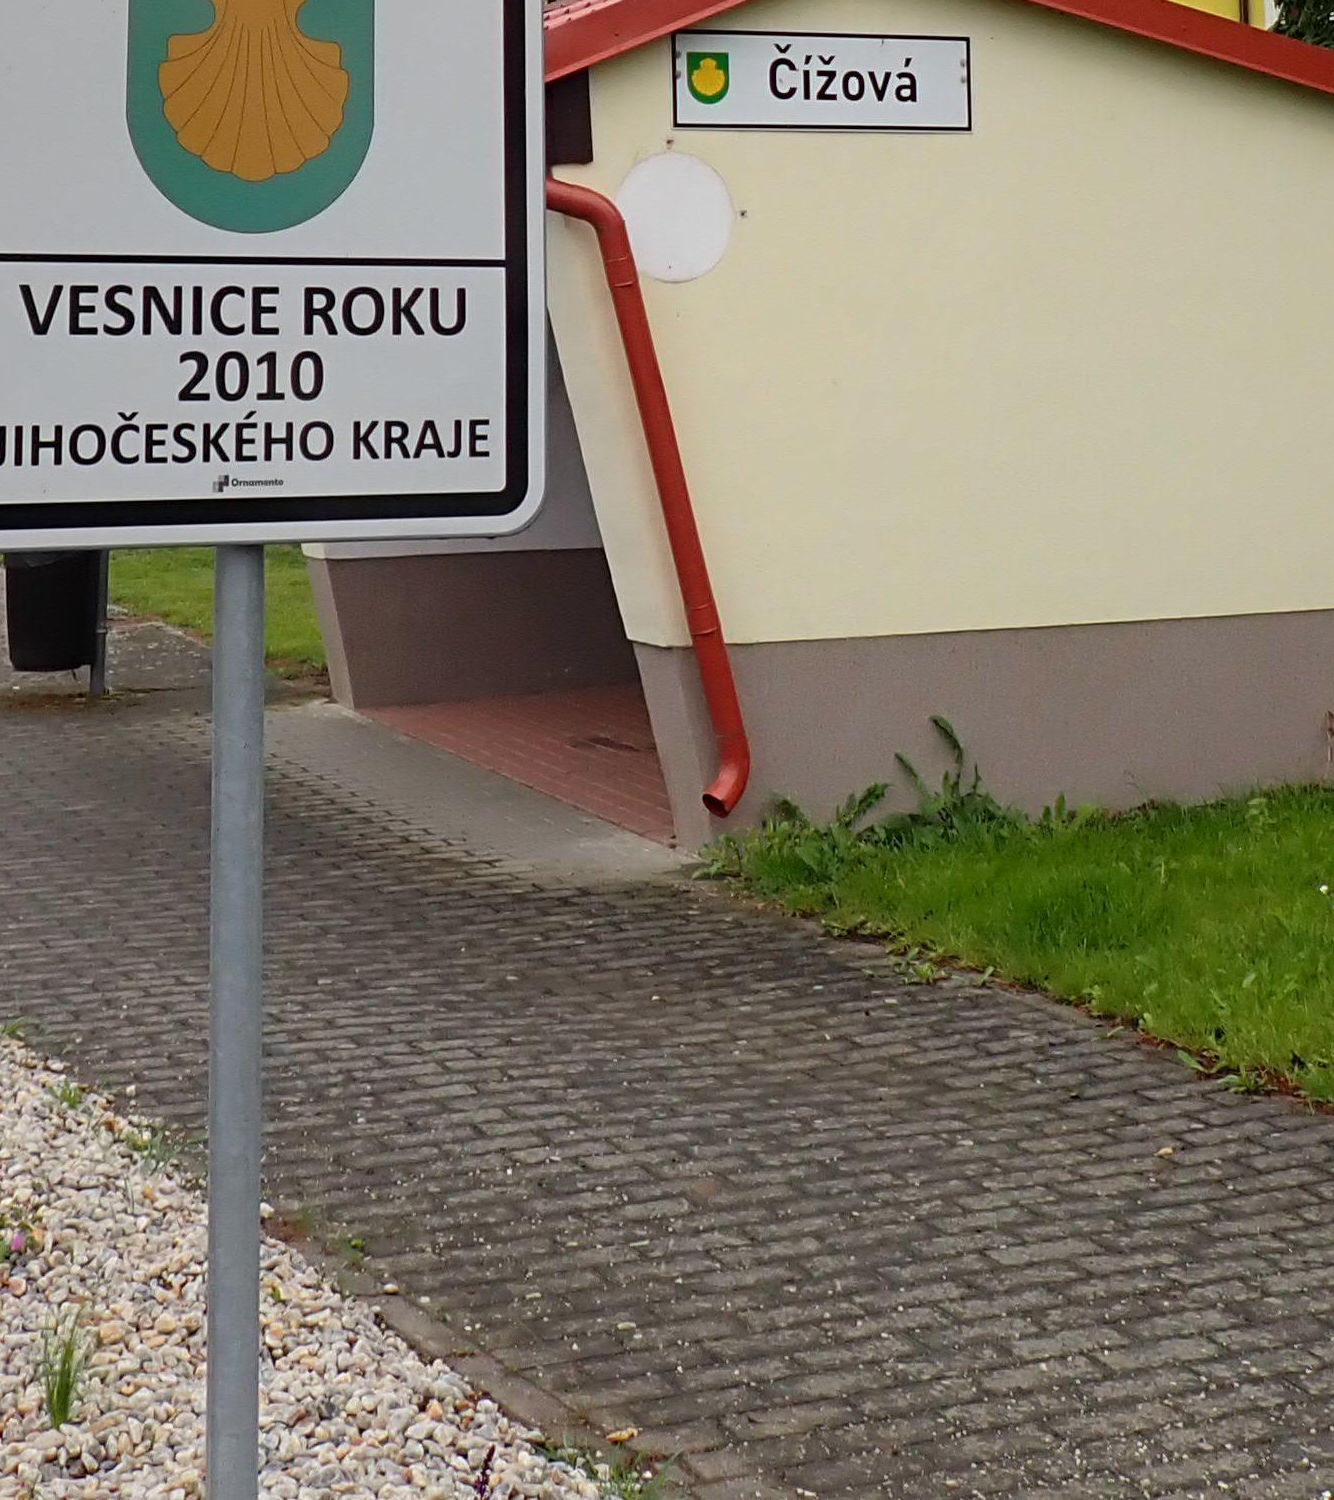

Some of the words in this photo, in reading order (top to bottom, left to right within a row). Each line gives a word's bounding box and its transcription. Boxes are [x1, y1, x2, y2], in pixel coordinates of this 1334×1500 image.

[769, 43, 918, 103] Čížová
[18, 284, 280, 337] VESNICE
[303, 286, 467, 337] ROKU
[178, 350, 324, 402] 2010
[352, 418, 491, 461] KRAJE
